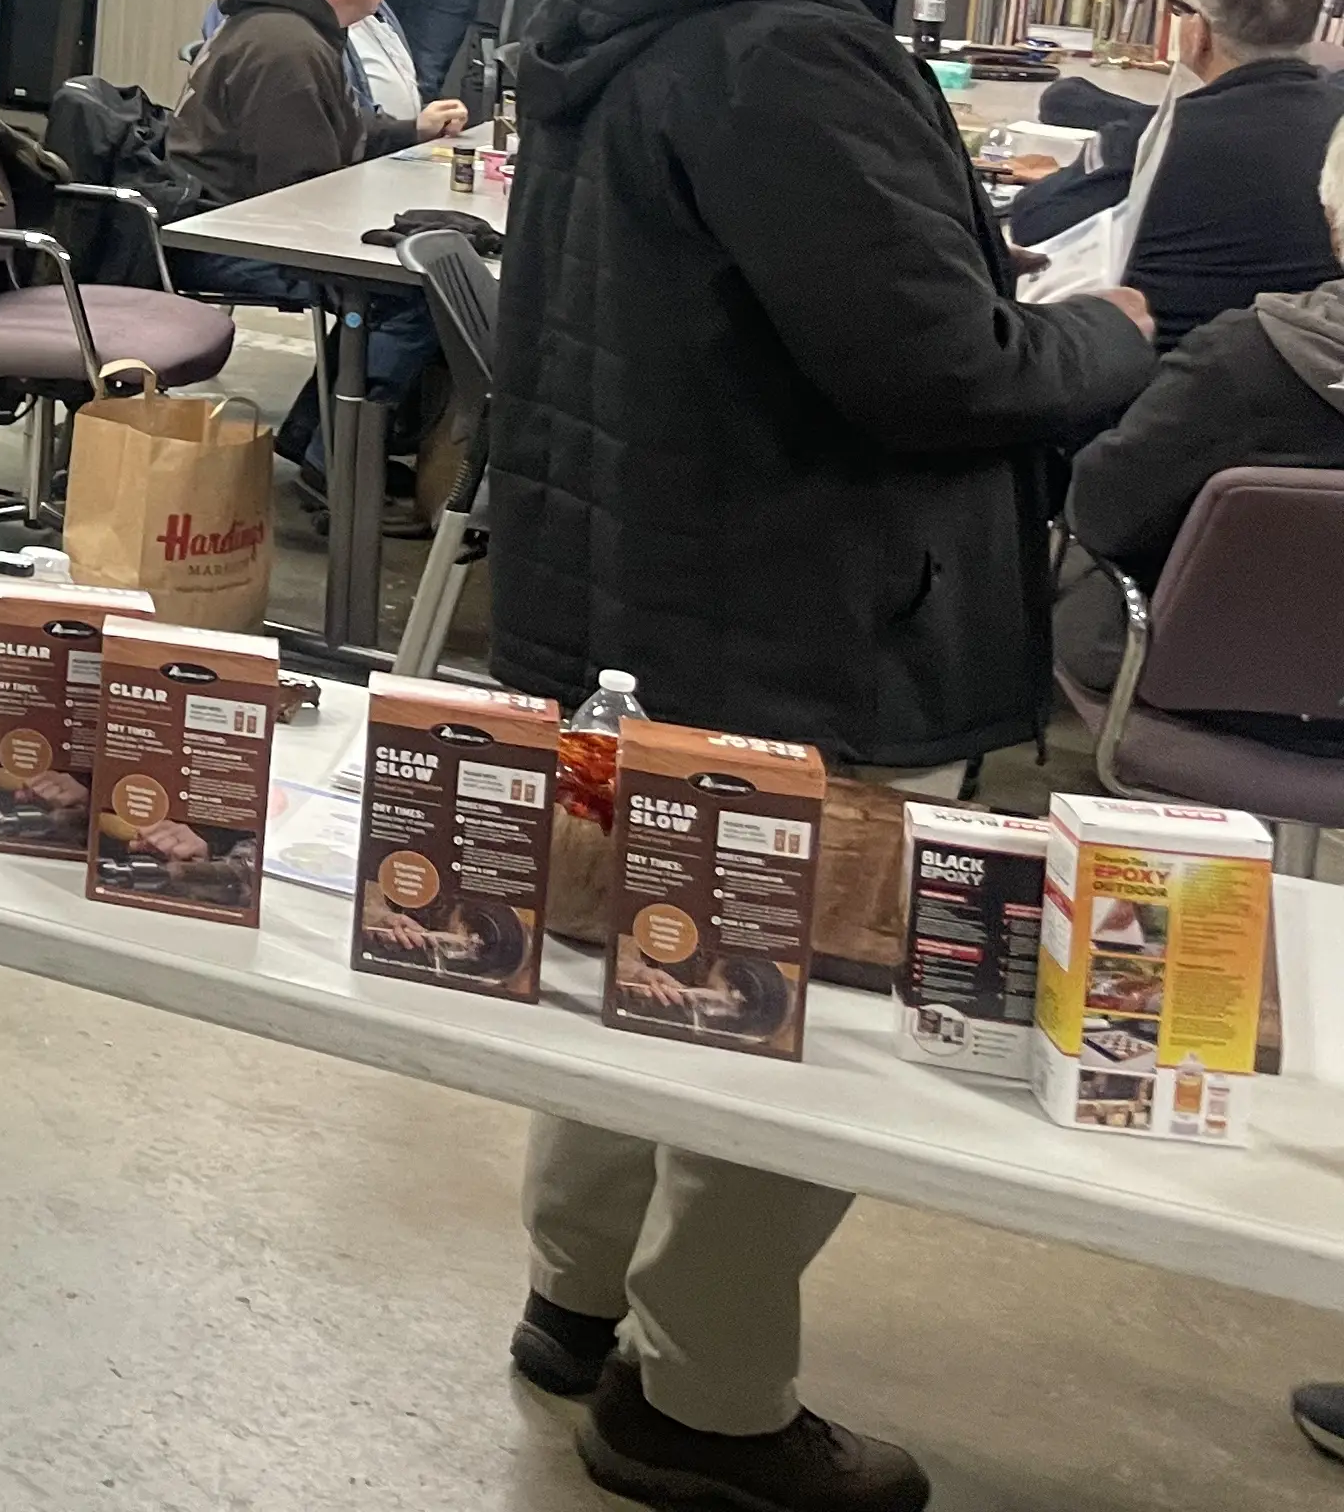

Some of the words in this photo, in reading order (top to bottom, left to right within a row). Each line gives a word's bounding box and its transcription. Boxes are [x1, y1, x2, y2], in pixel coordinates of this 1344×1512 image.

[109, 682, 169, 704] CLEAR
[375, 746, 439, 769] CLEAR
[375, 760, 435, 783] SLOW
[630, 794, 698, 820] CLEAR
[629, 809, 692, 833] SLOW
[921, 849, 986, 874] BLACK
[920, 865, 984, 886] EPOXY
[1094, 863, 1172, 885] EPOXY
